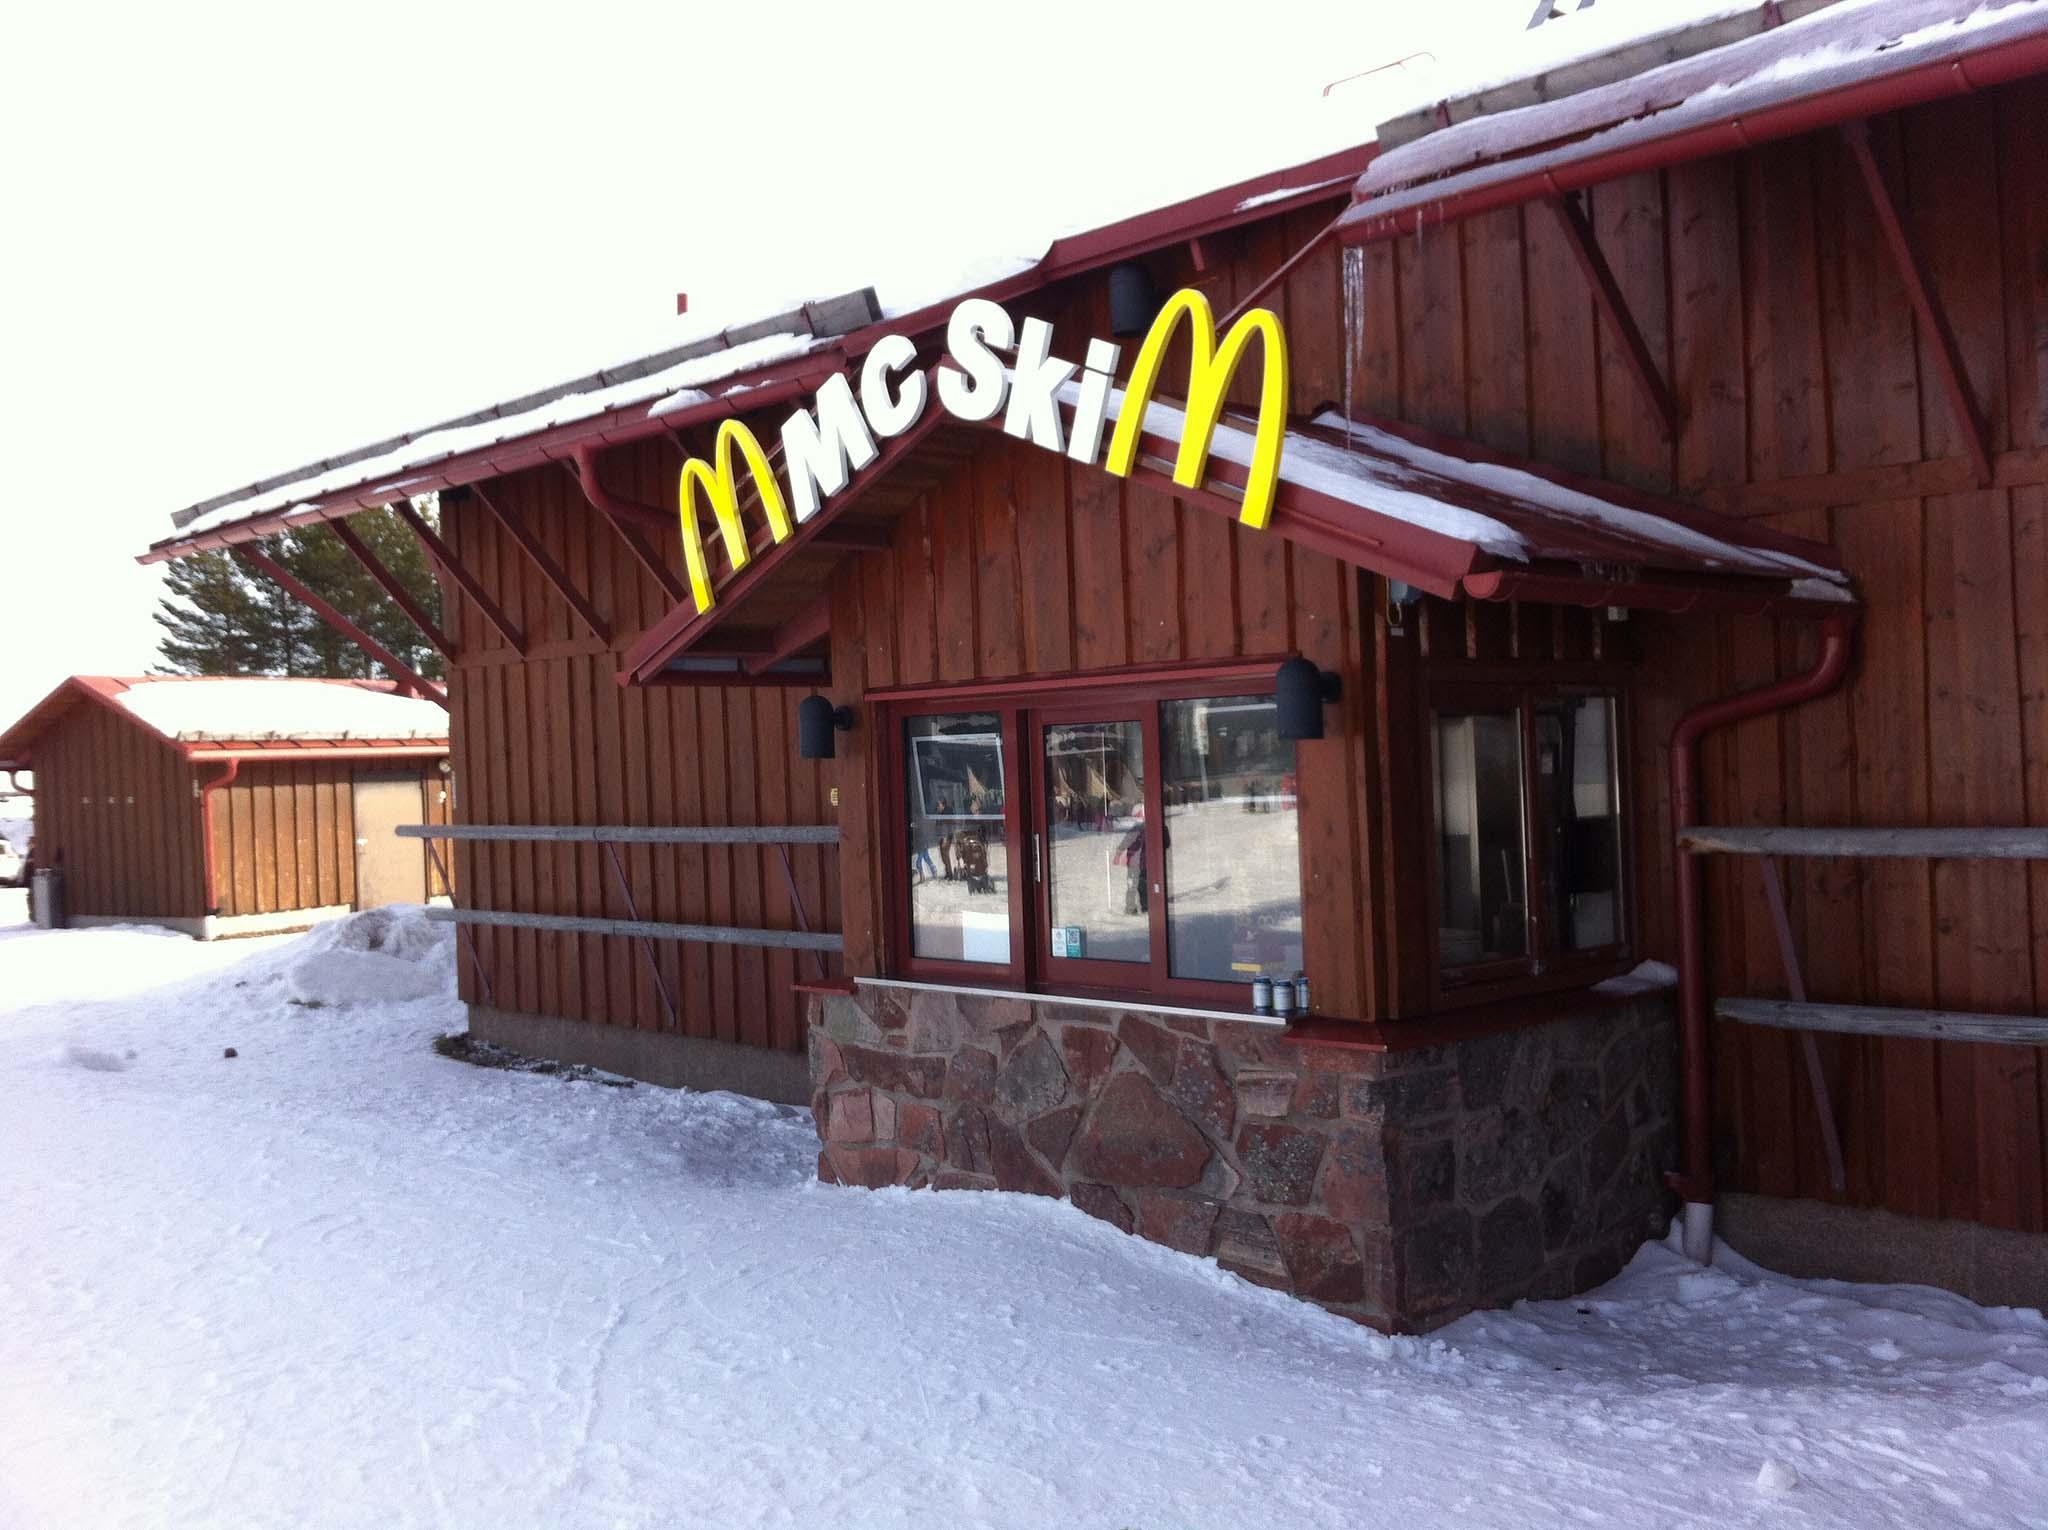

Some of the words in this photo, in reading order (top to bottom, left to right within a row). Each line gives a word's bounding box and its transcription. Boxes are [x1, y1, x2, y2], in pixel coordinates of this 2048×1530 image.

[679, 418, 793, 614] M
[938, 298, 1122, 465] Ski
[1105, 288, 1289, 529] M
